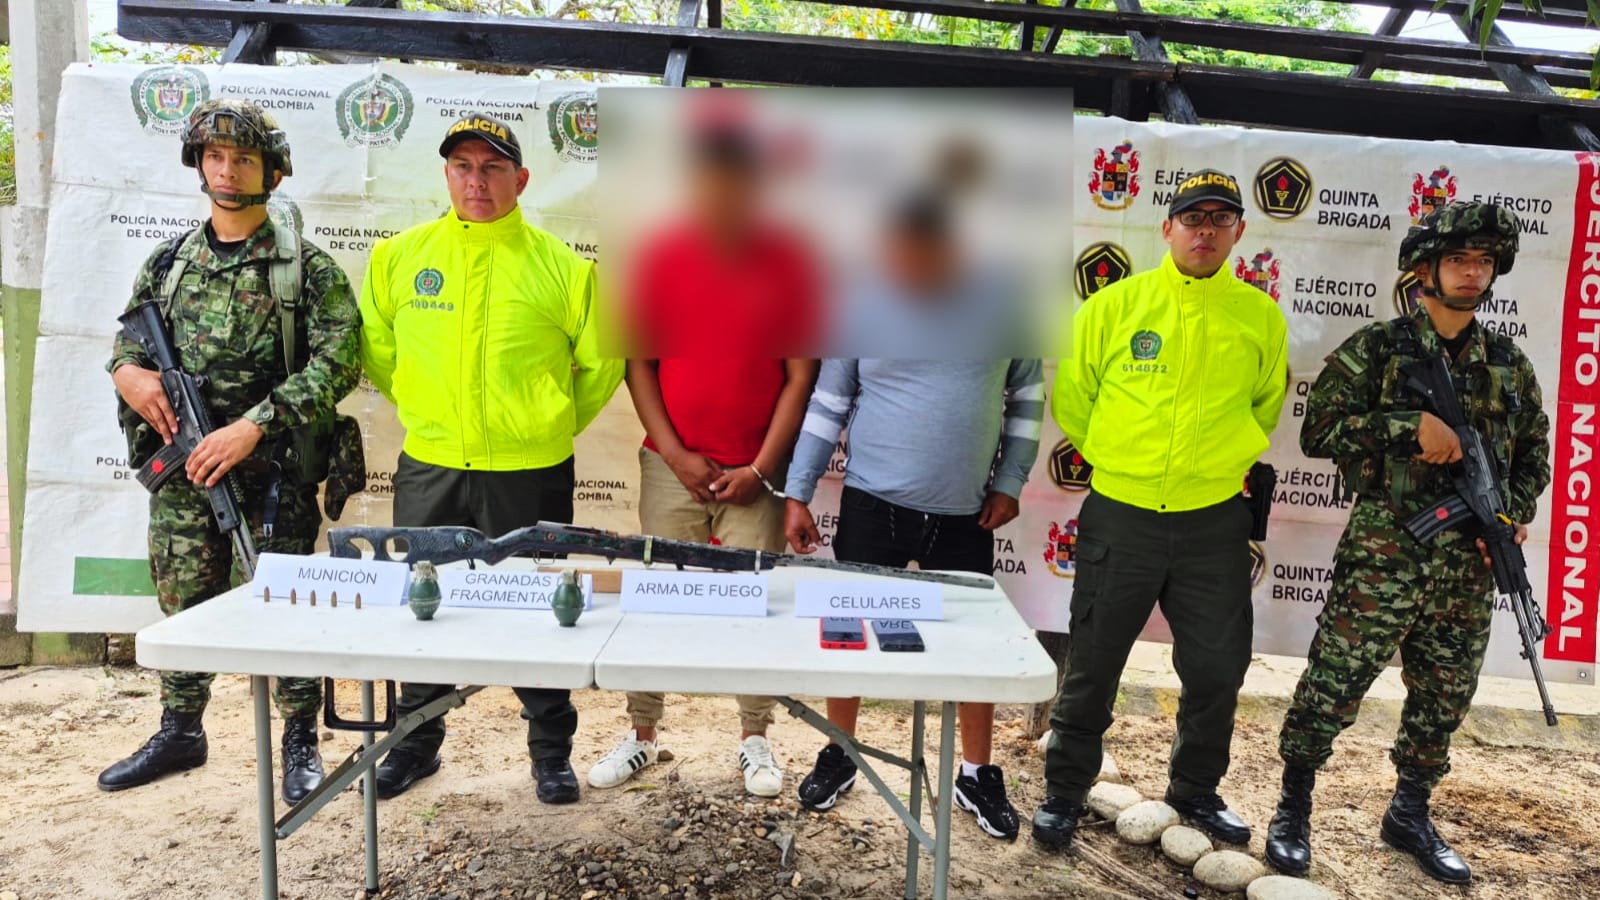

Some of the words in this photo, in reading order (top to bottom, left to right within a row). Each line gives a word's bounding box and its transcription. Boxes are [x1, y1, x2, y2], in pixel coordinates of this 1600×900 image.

[270, 87, 332, 99] NACIONAL
[440, 108, 456, 118] DE
[1178, 173, 1237, 195] POLICIA
[1319, 189, 1379, 208] QUINTA
[111, 214, 157, 226] POLICÍA
[161, 216, 205, 228] NACIO
[1318, 210, 1391, 230] BRIGADA
[127, 228, 142, 238] DE
[315, 226, 361, 238] POLICÍA
[330, 240, 345, 250] DE
[1295, 276, 1377, 298] EJÉRCITO
[1292, 299, 1375, 318] NACIONAL
[1480, 319, 1528, 338] GADA
[96, 456, 129, 467] POLI
[113, 470, 131, 480] DE
[1275, 467, 1346, 488] JÉRCI
[573, 491, 613, 501] OMBIA
[1558, 403, 1596, 652] NACIONAL
[298, 567, 377, 585] MUNICIÓN
[465, 572, 552, 587] GRANADAS
[1273, 563, 1334, 583] QUINTA
[635, 582, 679, 596] ARMA
[683, 583, 703, 597] DE
[708, 584, 763, 598] FUEGO
[1272, 584, 1330, 604] BRIGA
[829, 596, 921, 610] CELULARES
